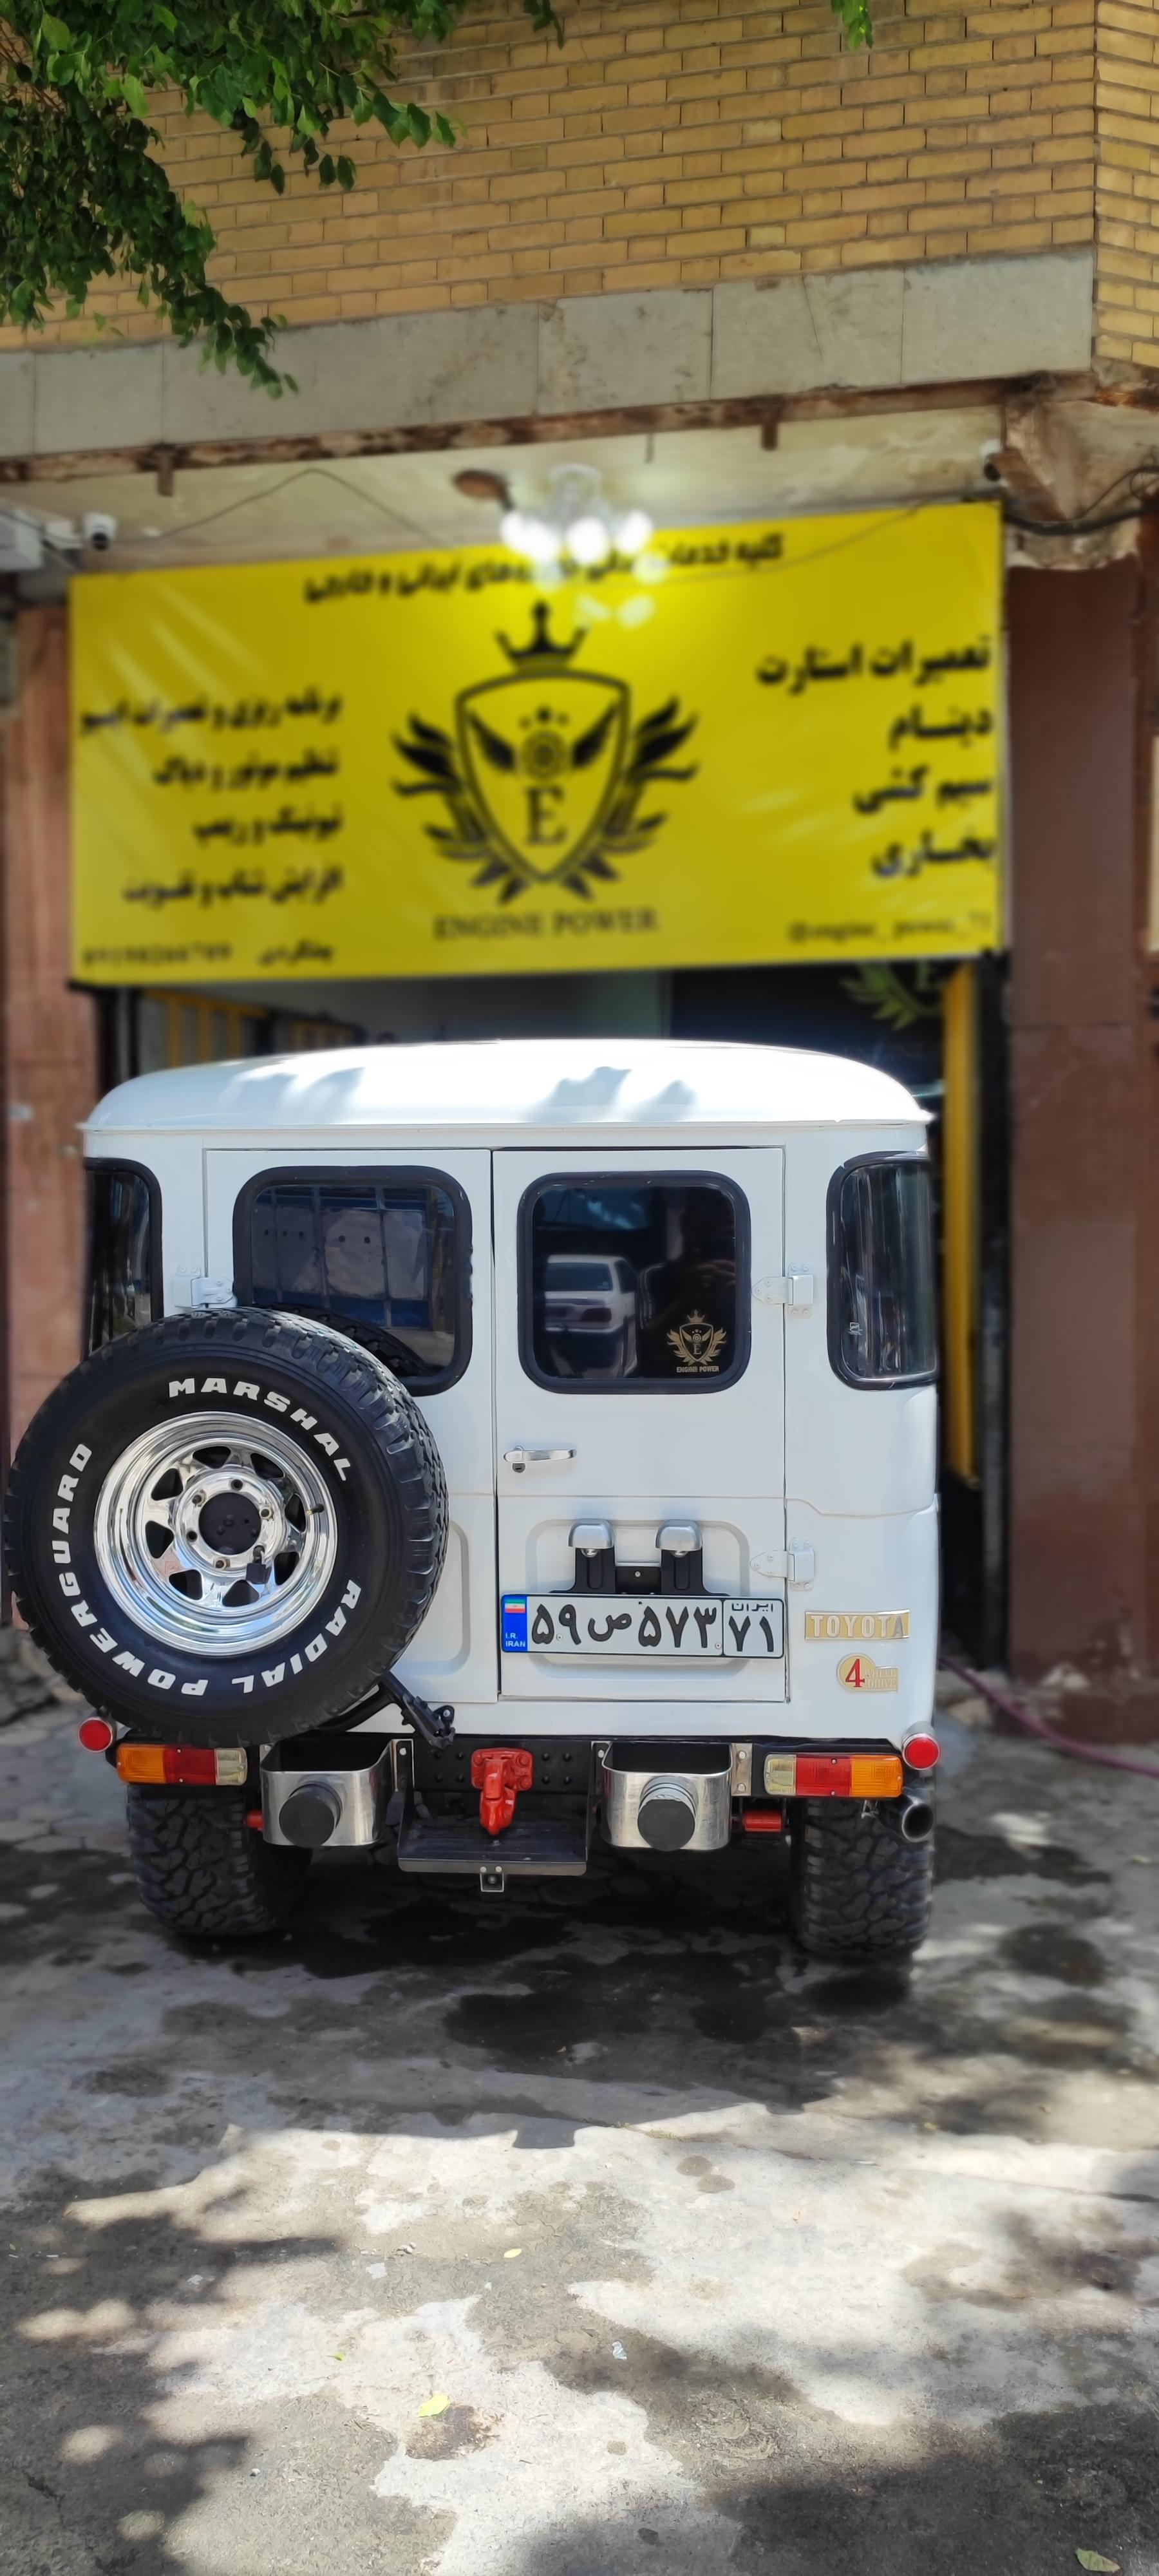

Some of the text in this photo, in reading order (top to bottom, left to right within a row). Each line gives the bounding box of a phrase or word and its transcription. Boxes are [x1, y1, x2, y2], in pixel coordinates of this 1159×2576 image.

[755, 633, 992, 696] تعمیرات استارت
[433, 909, 658, 940] ENGINE POWER
[169, 1378, 352, 1481] MARSHAL
[731, 1603, 774, 1612] ایران
[231, 1579, 362, 1694] RADIAL
[728, 1615, 775, 1653] ۷۱
[811, 1615, 905, 1638] TOYOTA
[844, 1658, 865, 1689] 4
